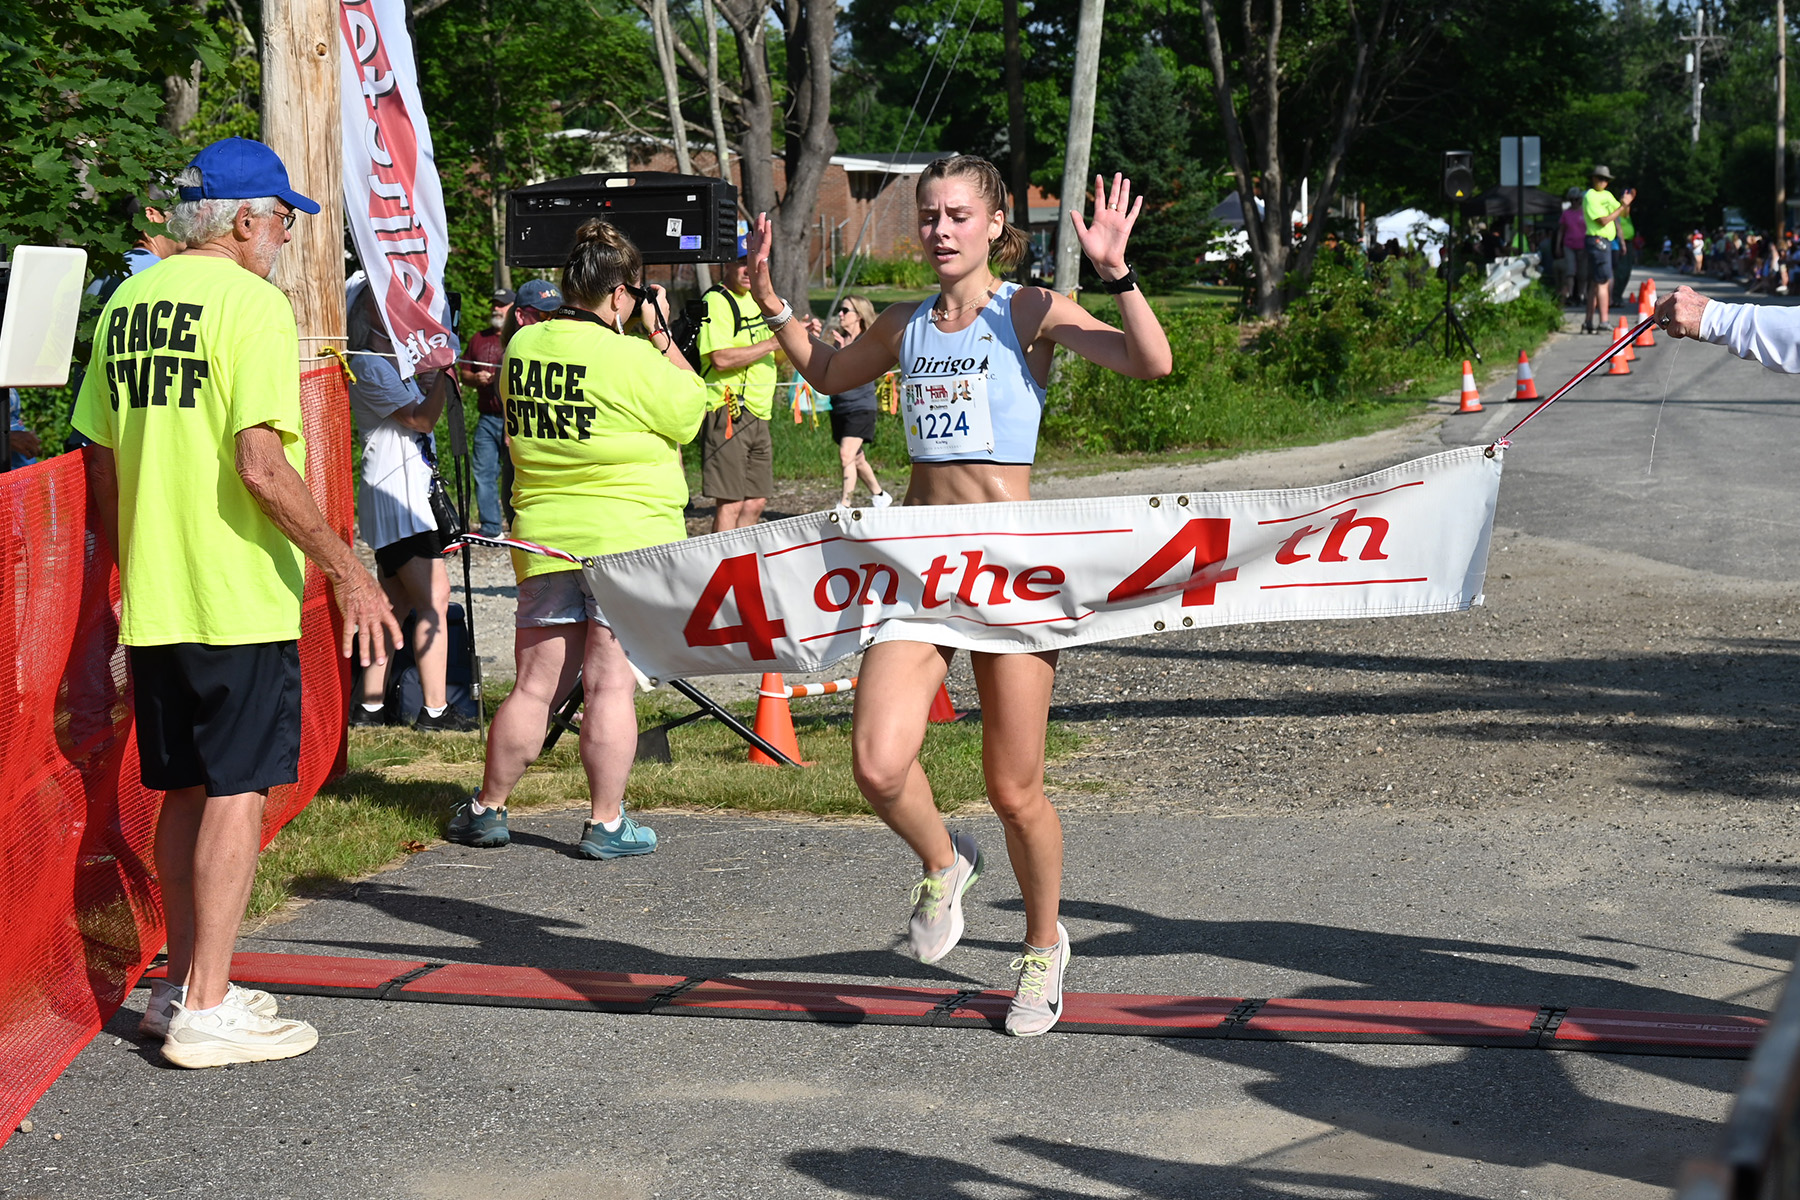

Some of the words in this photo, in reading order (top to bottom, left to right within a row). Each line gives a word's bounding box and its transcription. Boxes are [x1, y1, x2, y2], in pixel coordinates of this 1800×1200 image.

[107, 300, 203, 356] RACE
[508, 357, 587, 402] RACE
[908, 355, 976, 378] Dirigo
[506, 398, 597, 440] STAFF
[916, 410, 970, 440] 1224
[682, 552, 787, 661] 4
[813, 562, 899, 613] on
[920, 550, 1066, 610] the
